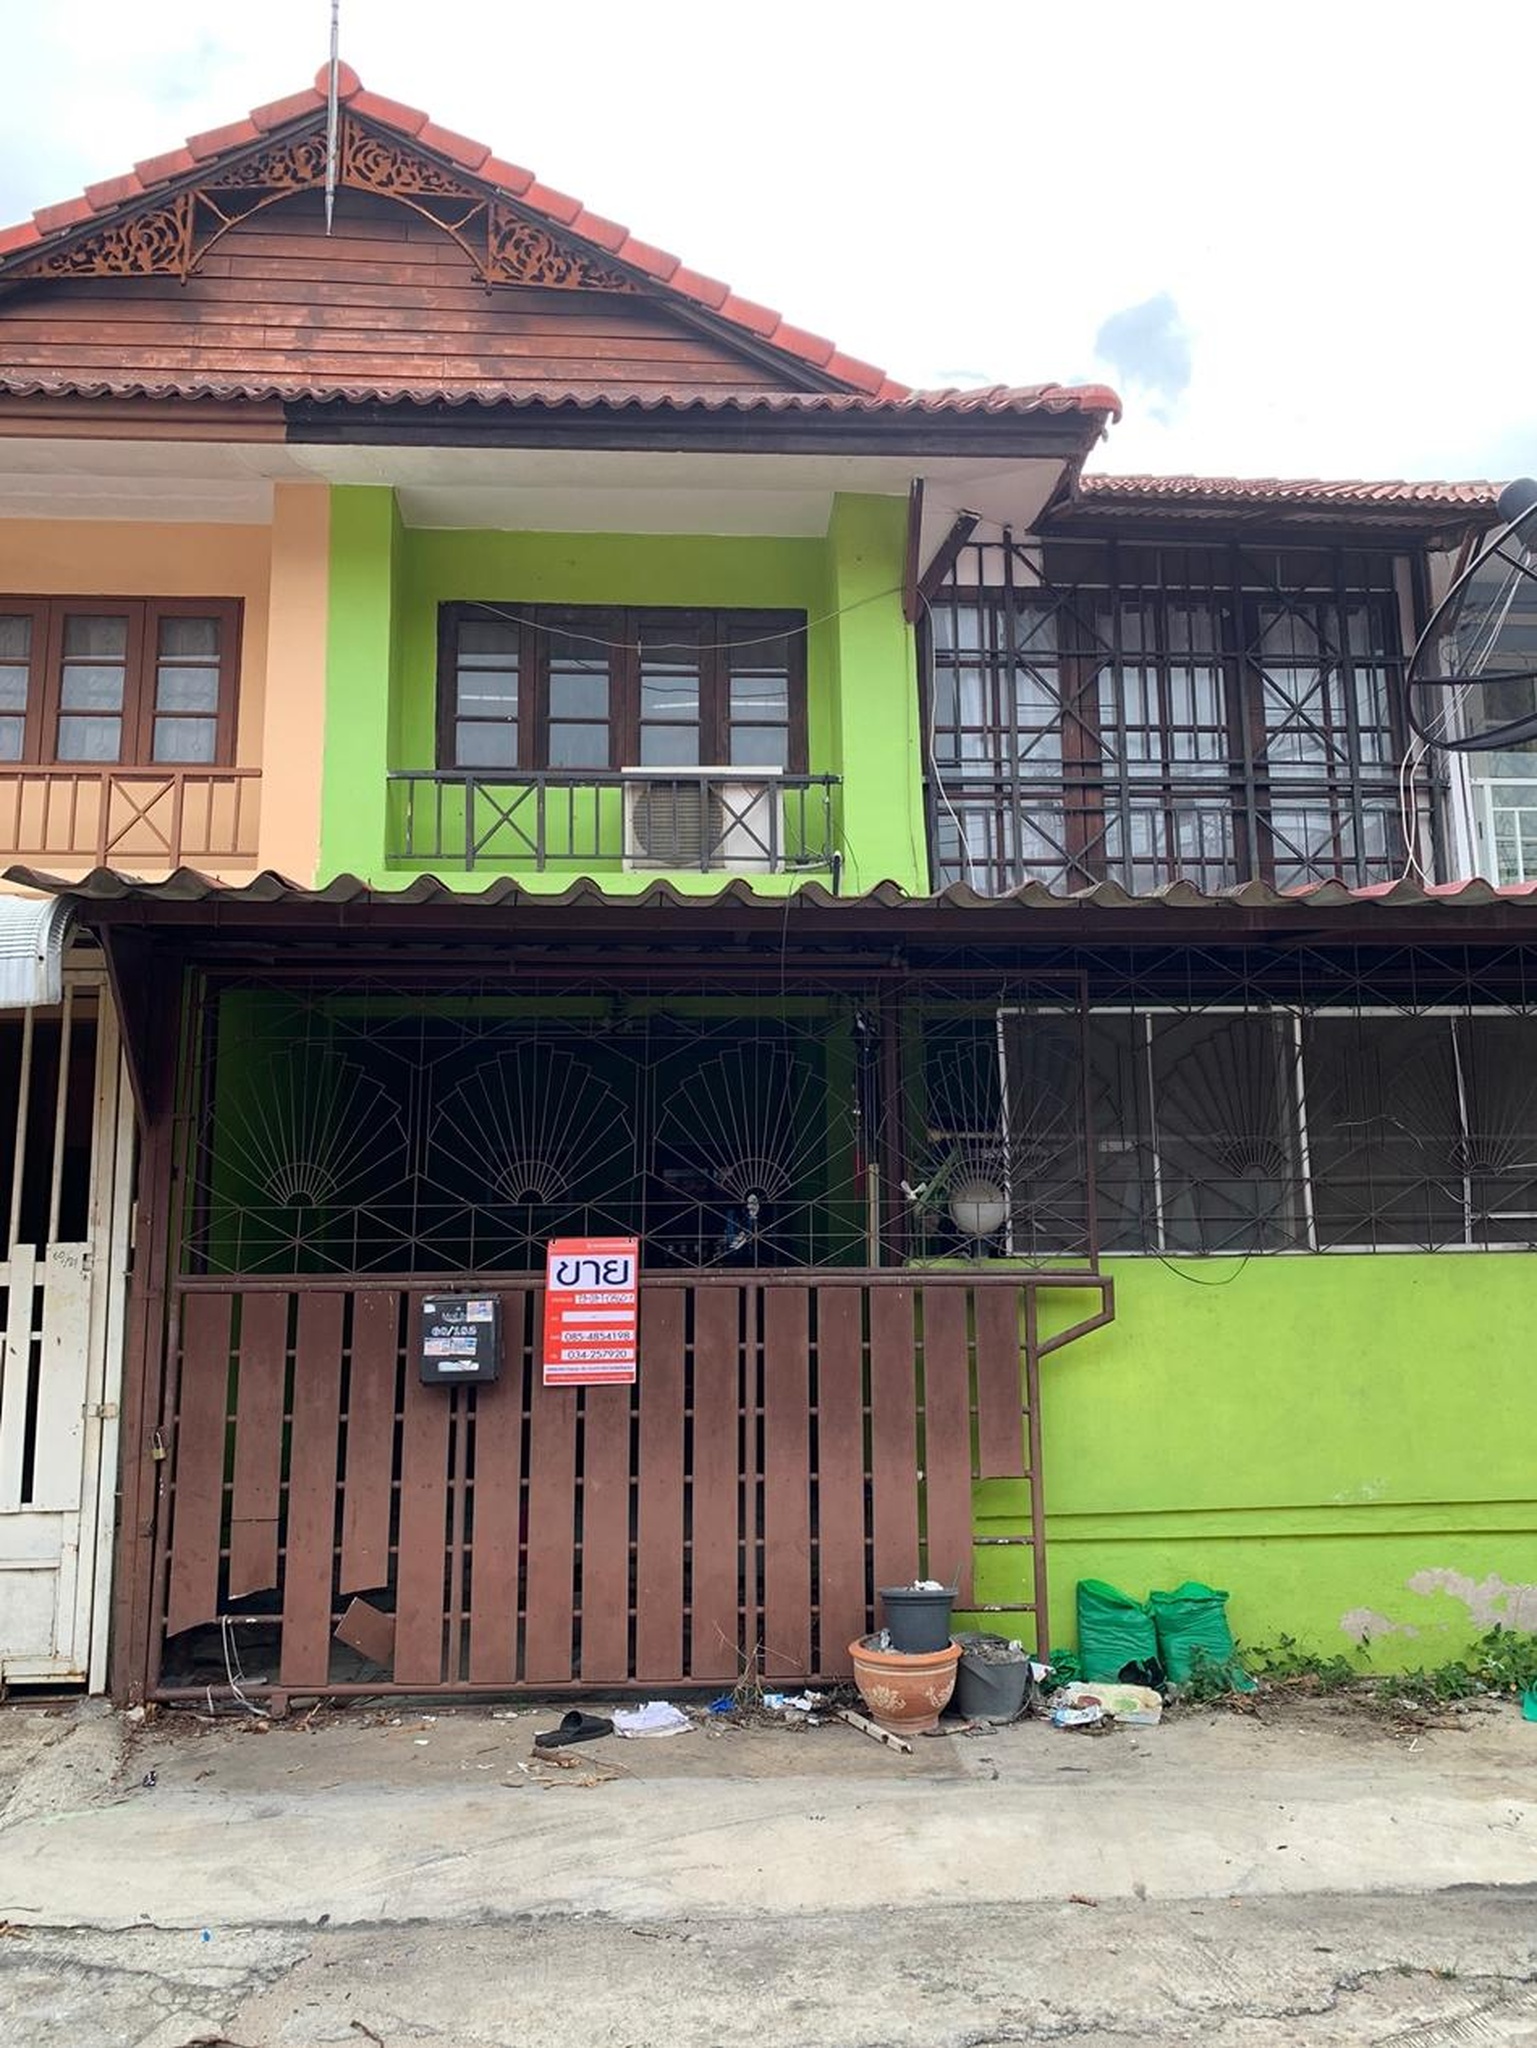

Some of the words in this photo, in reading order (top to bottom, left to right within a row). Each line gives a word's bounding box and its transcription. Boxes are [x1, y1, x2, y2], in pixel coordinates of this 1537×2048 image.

[556, 1259, 629, 1286] ขาย
[564, 1332, 631, 1341] 085-4854198
[567, 1350, 628, 1360] 034-257920
